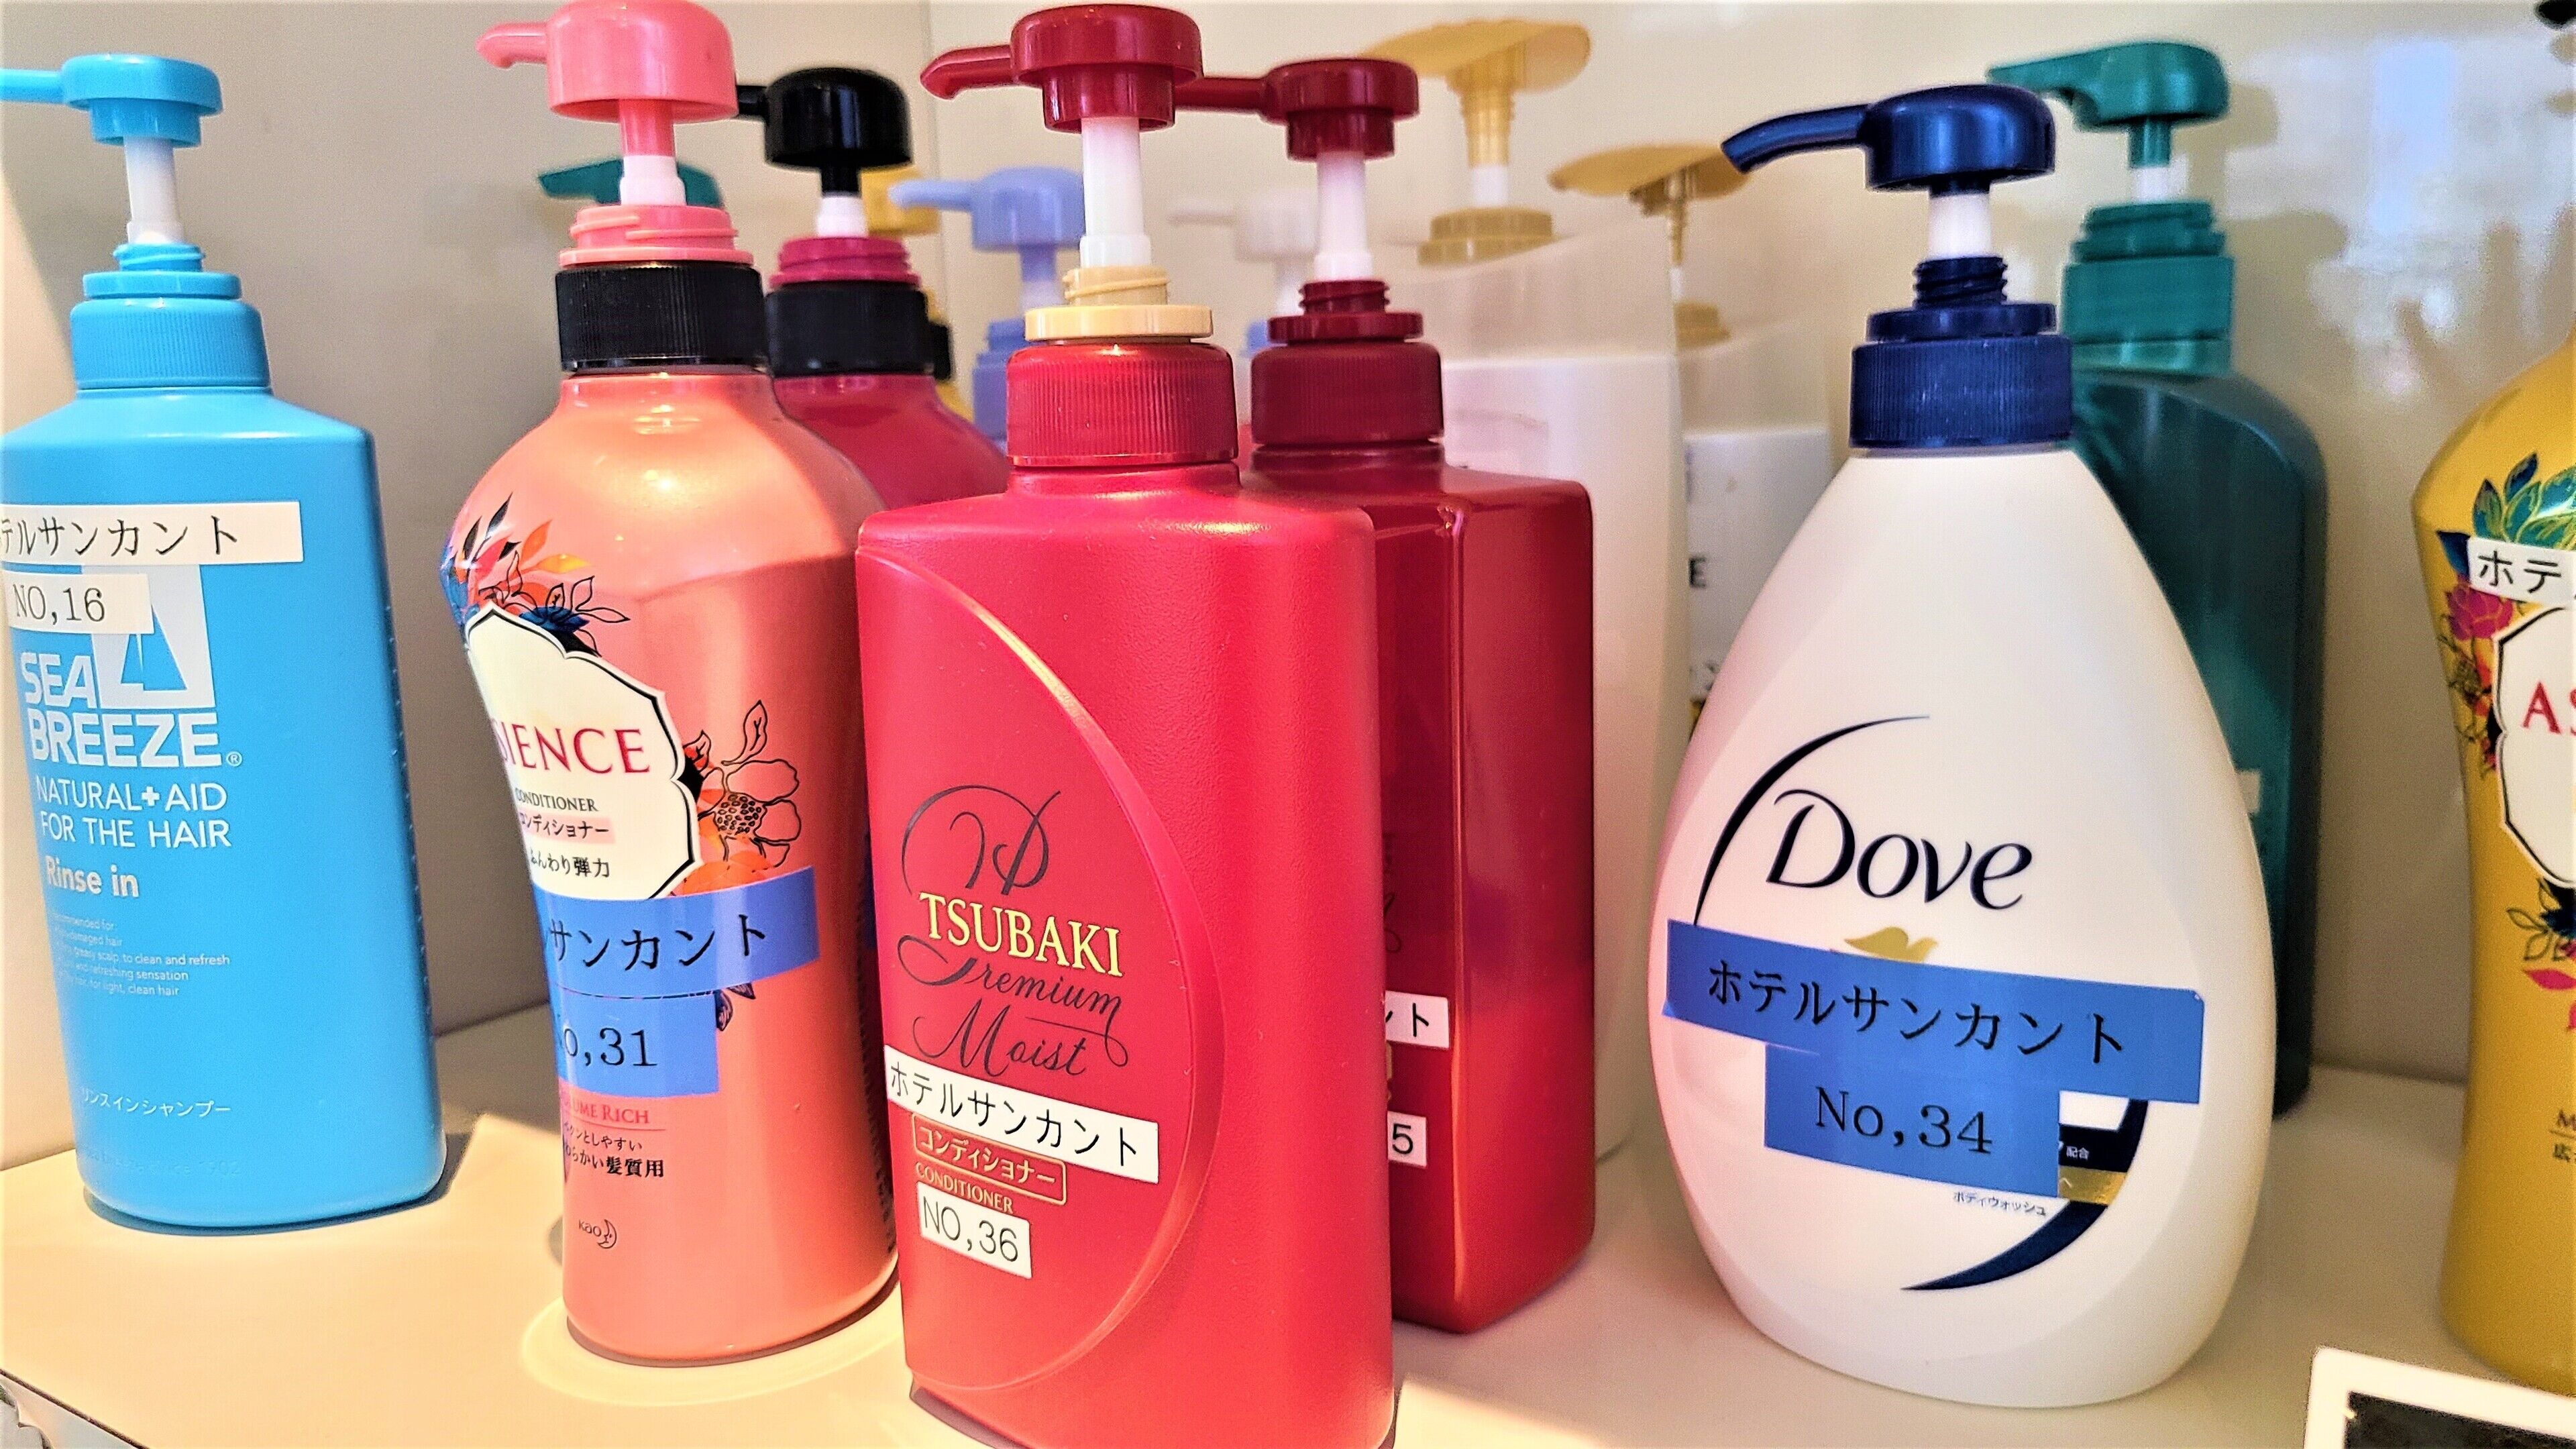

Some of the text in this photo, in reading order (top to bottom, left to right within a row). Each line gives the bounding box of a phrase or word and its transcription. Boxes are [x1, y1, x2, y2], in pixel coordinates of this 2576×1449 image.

[2477, 550, 2576, 594] ホテ
[13, 583, 105, 625] NO,16
[20, 651, 97, 709] SEA
[25, 710, 222, 768] BREEZE
[515, 787, 599, 812] CONDITIONER
[40, 810, 232, 849] FOR THE HAIR
[1766, 789, 2033, 910] Dove
[45, 855, 140, 898] Rinse in
[135, 953, 162, 965] clean
[165, 954, 186, 965] and
[189, 954, 230, 965] refresh
[919, 892, 1124, 977] TSUBAKI
[127, 981, 156, 994] clean
[158, 983, 180, 996] hair
[136, 968, 189, 981] sensation
[913, 998, 1087, 1078] Moist
[1385, 1002, 1429, 1037] ト
[1708, 960, 2123, 1064] ホテルサンカント
[890, 1061, 1137, 1167] ホテルサンカント
[1816, 1087, 1993, 1155] No,34
[919, 1126, 1056, 1185] コンディショナー
[916, 1161, 1014, 1214] CONDITIONER
[922, 1195, 1019, 1263] NO,36
